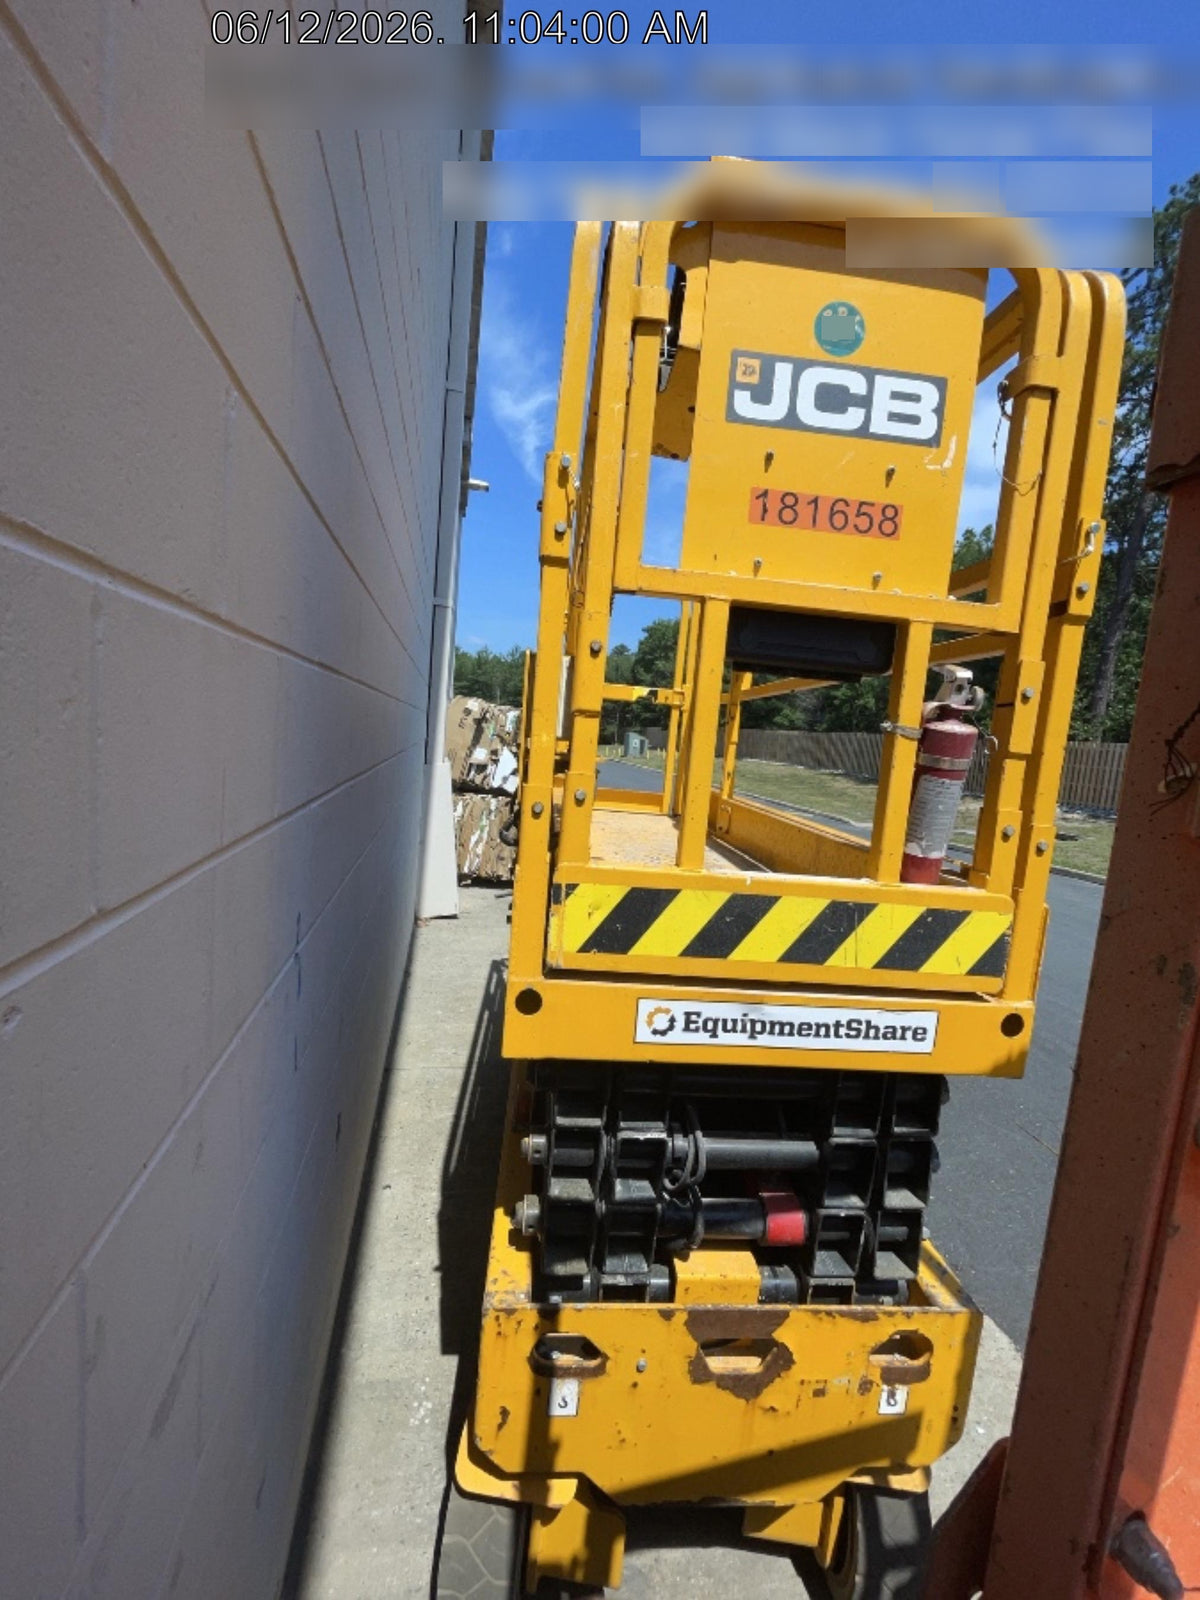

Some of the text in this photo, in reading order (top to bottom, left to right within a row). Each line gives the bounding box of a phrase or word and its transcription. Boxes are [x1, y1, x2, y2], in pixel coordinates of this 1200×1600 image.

[733, 362, 940, 440] JCB
[755, 488, 899, 538] 181658
[682, 1011, 928, 1042] EquipmentShare
